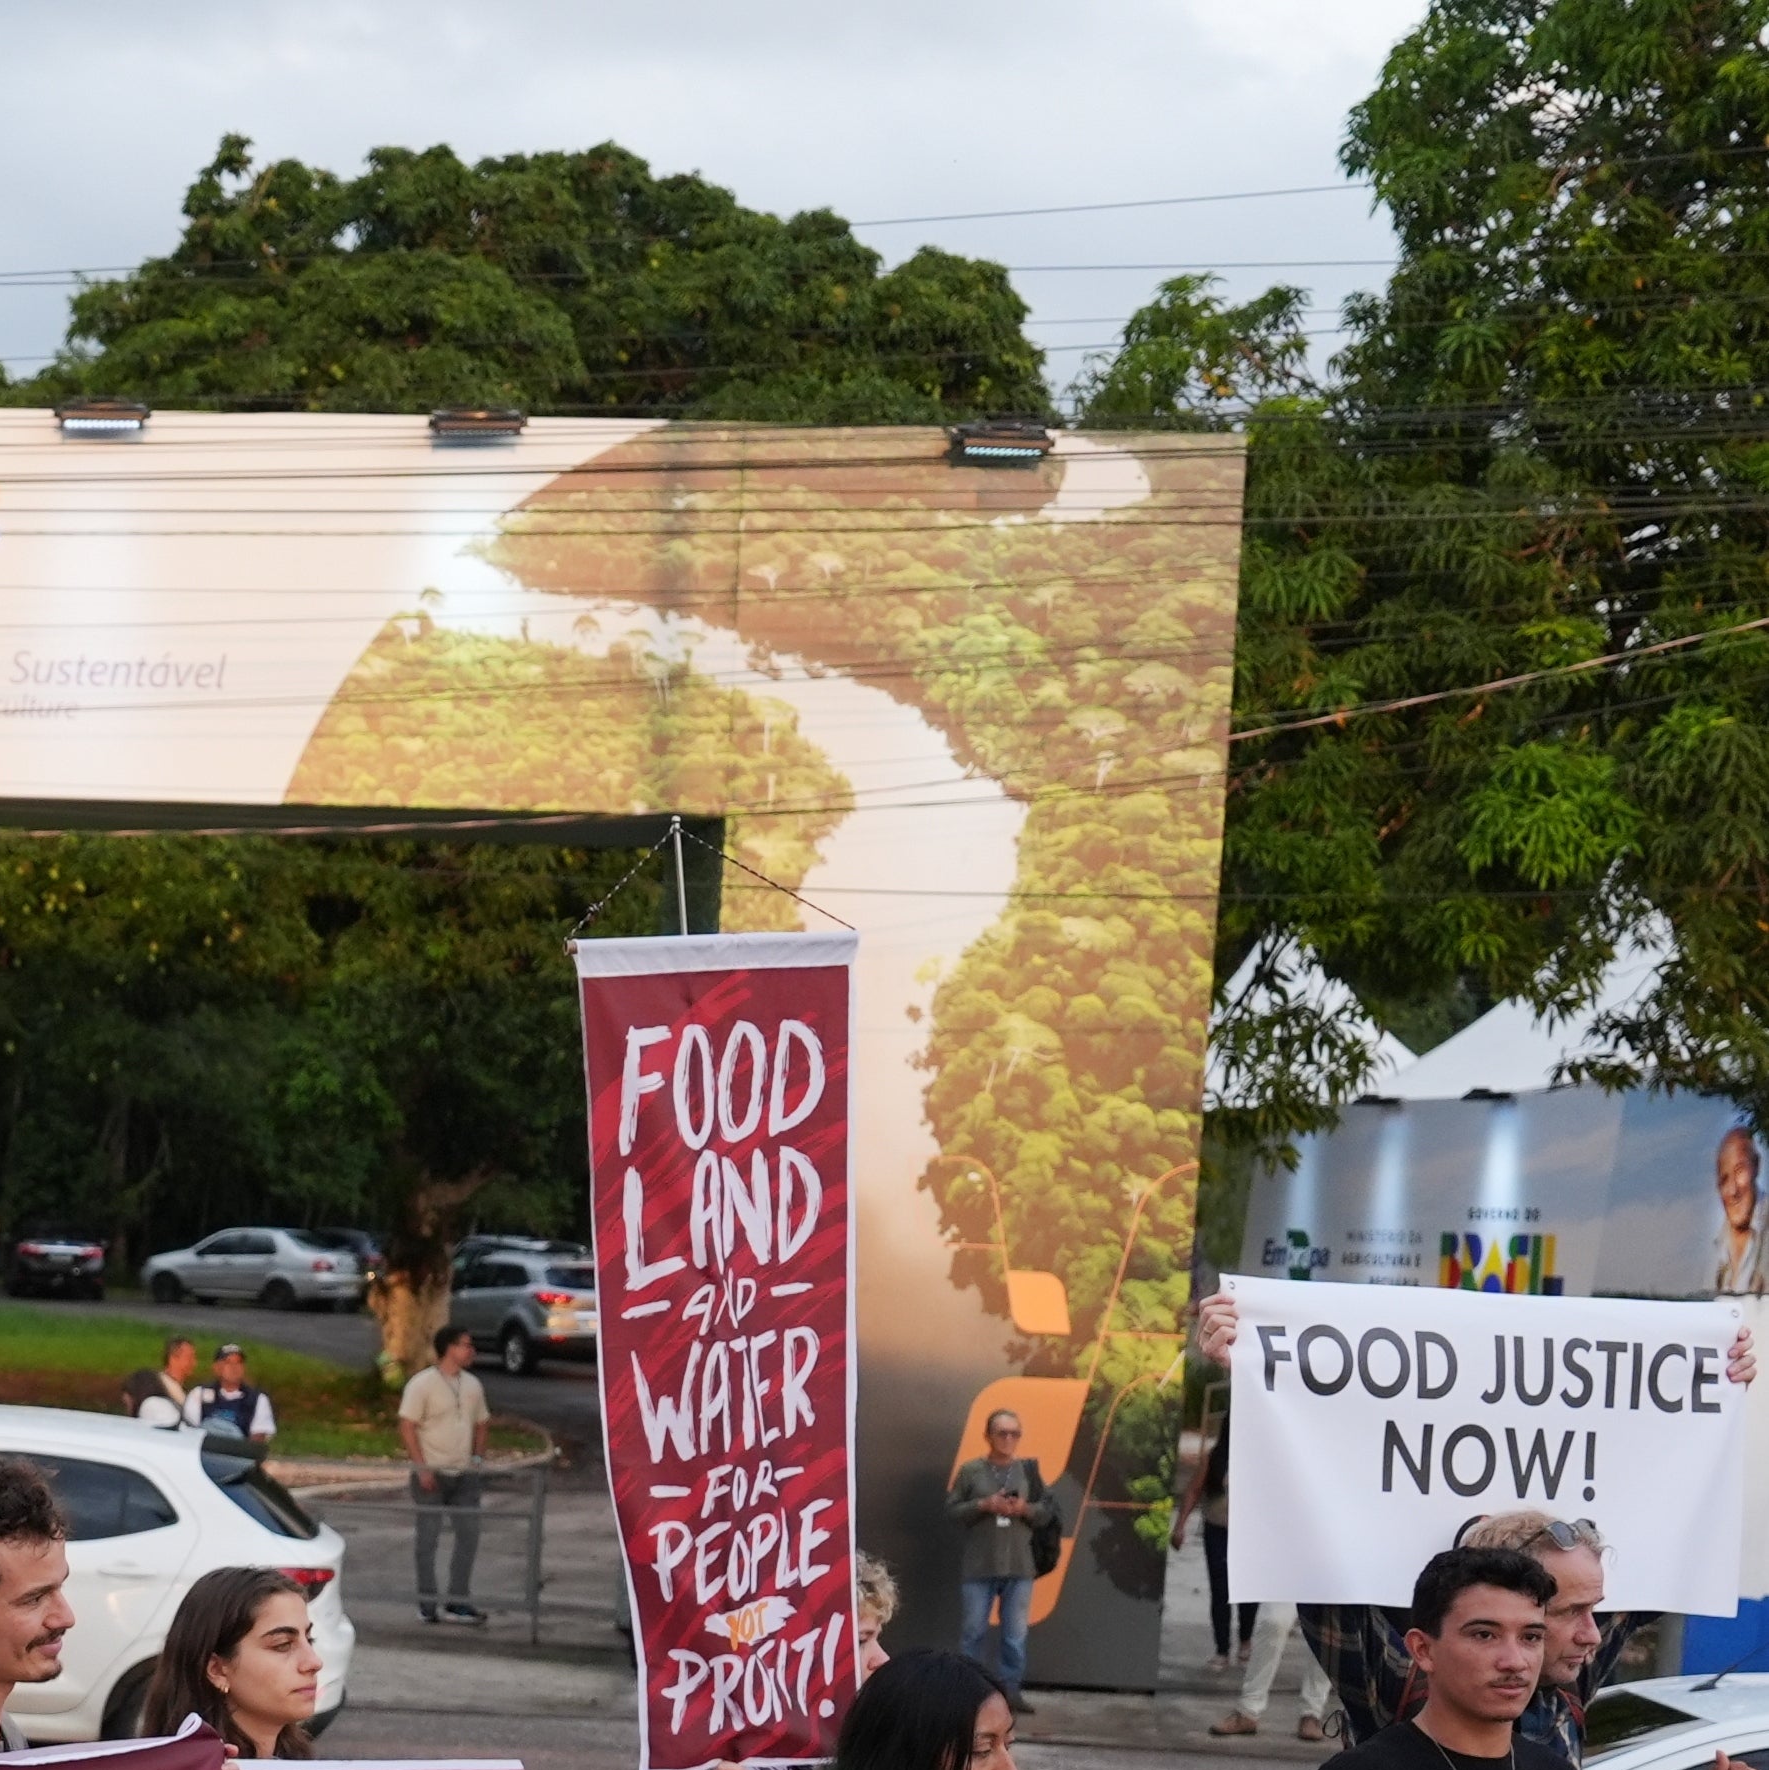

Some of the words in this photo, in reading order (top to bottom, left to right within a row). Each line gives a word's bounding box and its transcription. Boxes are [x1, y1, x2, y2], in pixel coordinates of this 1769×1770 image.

[9, 650, 228, 689] Sustentável
[618, 1018, 827, 1157] FOOD
[623, 1145, 823, 1292] LAND
[1438, 1231, 1565, 1297] BRASIL
[630, 1325, 821, 1464] WATER
[1256, 1323, 1459, 1401] FOOD
[1480, 1333, 1723, 1414] JUSTICE
[1381, 1419, 1597, 1503] NOW!
[647, 1497, 835, 1606] PEOPLE
